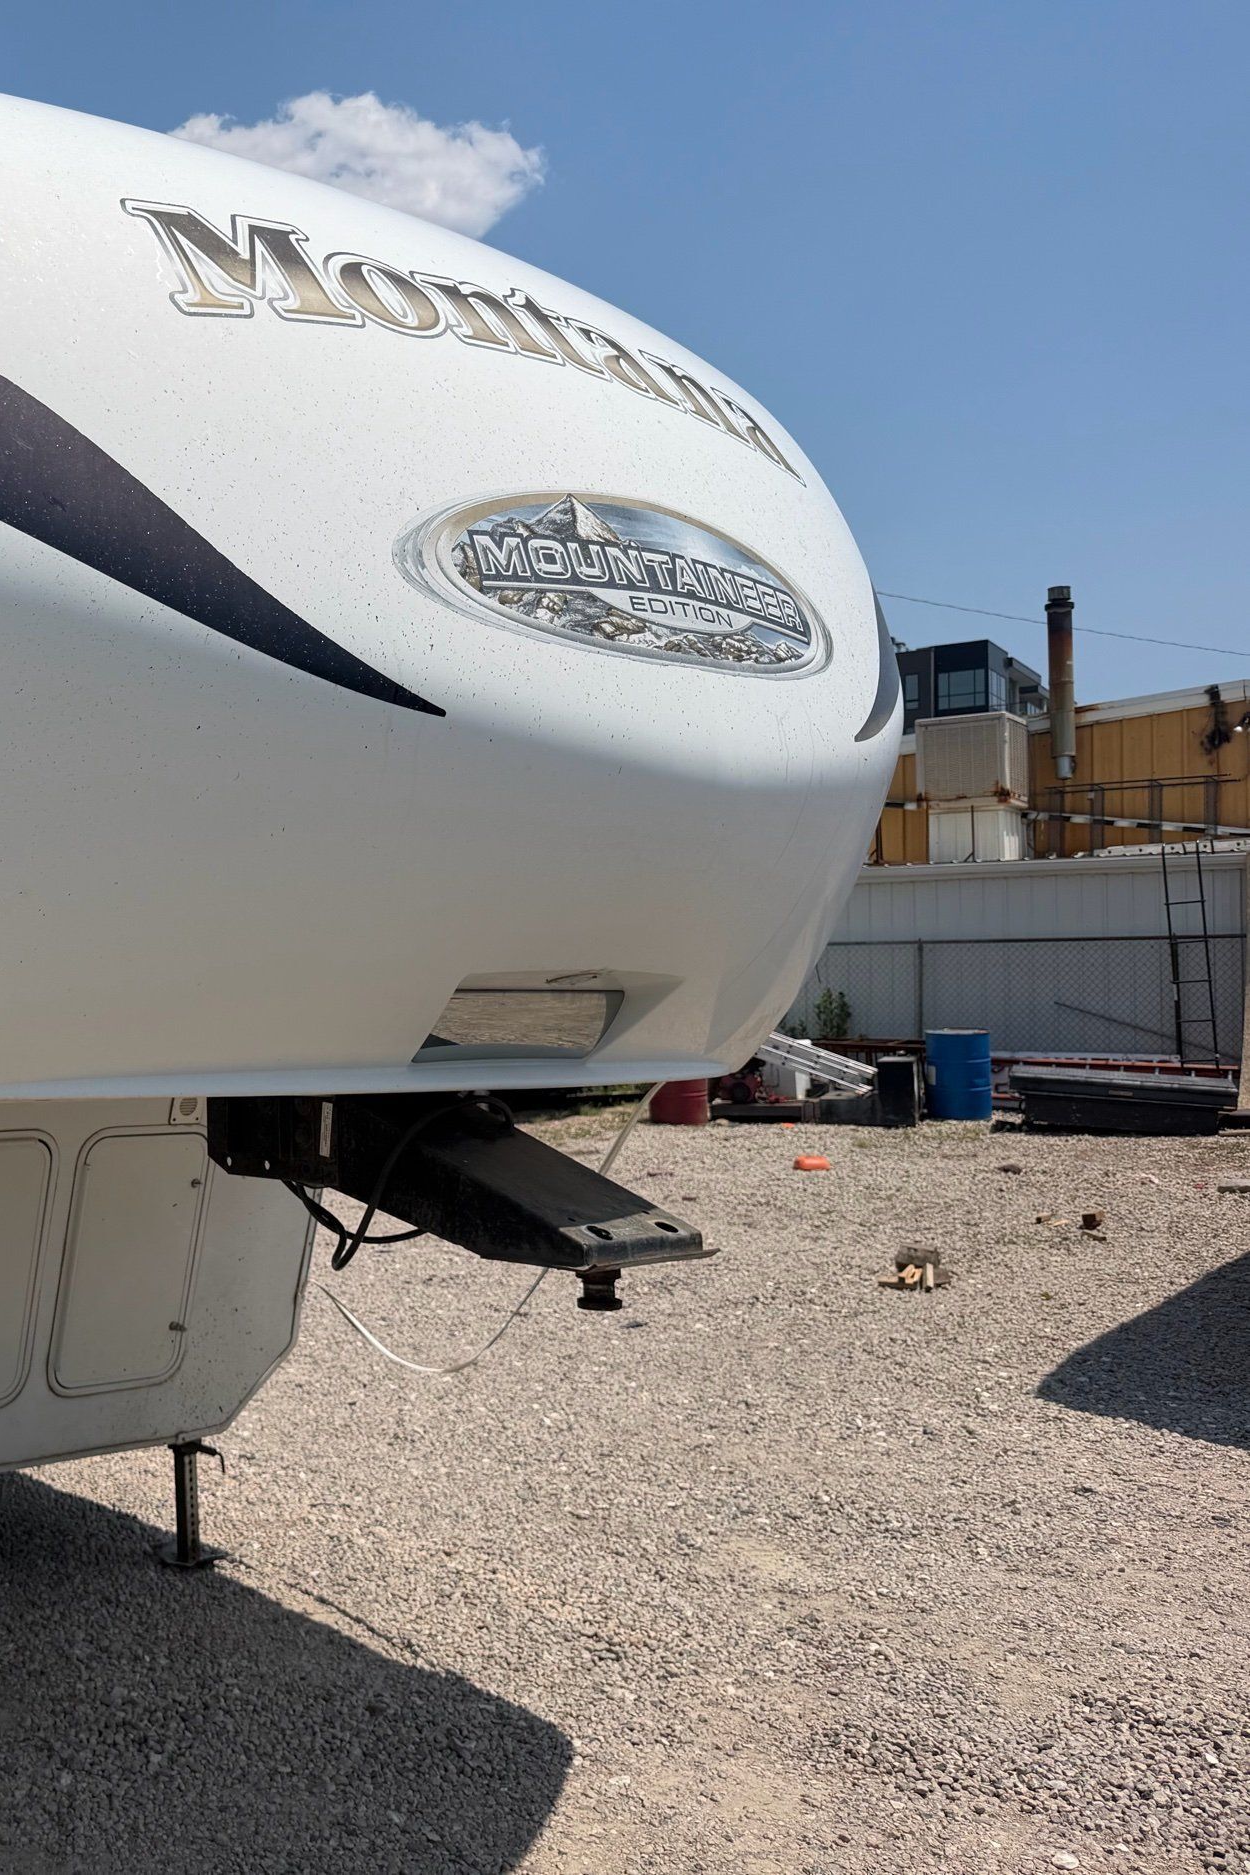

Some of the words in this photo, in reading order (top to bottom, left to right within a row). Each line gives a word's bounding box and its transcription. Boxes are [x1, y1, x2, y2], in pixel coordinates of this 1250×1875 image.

[121, 198, 806, 487] Montana
[472, 533, 805, 632] MOUNTAINEER
[629, 595, 733, 629] EDITION
